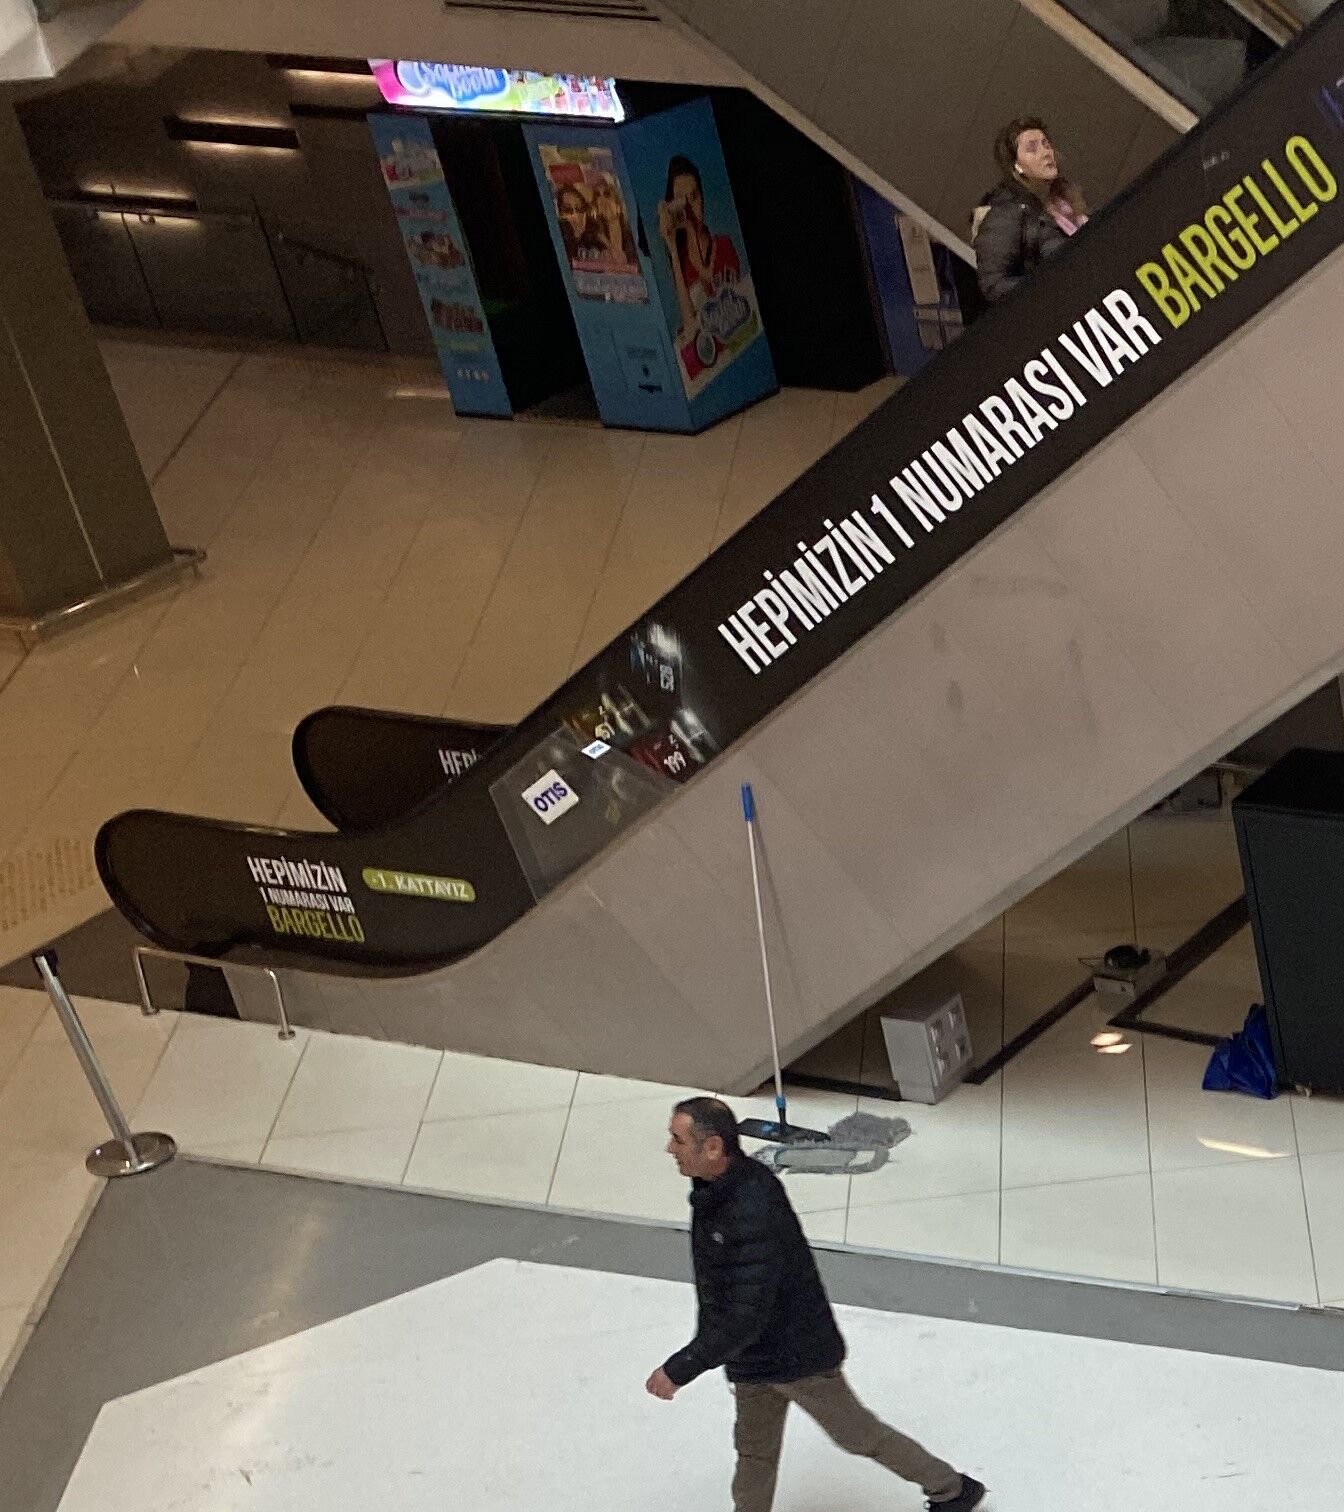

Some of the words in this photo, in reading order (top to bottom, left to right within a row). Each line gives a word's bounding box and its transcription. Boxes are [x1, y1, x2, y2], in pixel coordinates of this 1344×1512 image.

[1135, 136, 1338, 329] BARGELLO
[1058, 289, 1162, 388] VAR
[890, 350, 1087, 532] NUMARASI
[870, 494, 914, 548] 1
[718, 518, 896, 675] HEPİMİZİN
[533, 781, 568, 813] OTIS
[247, 856, 347, 893] HEPİMİZİN
[268, 887, 330, 910] NUMARASI
[330, 894, 355, 914] VAR
[267, 904, 365, 943] BARGELLO
